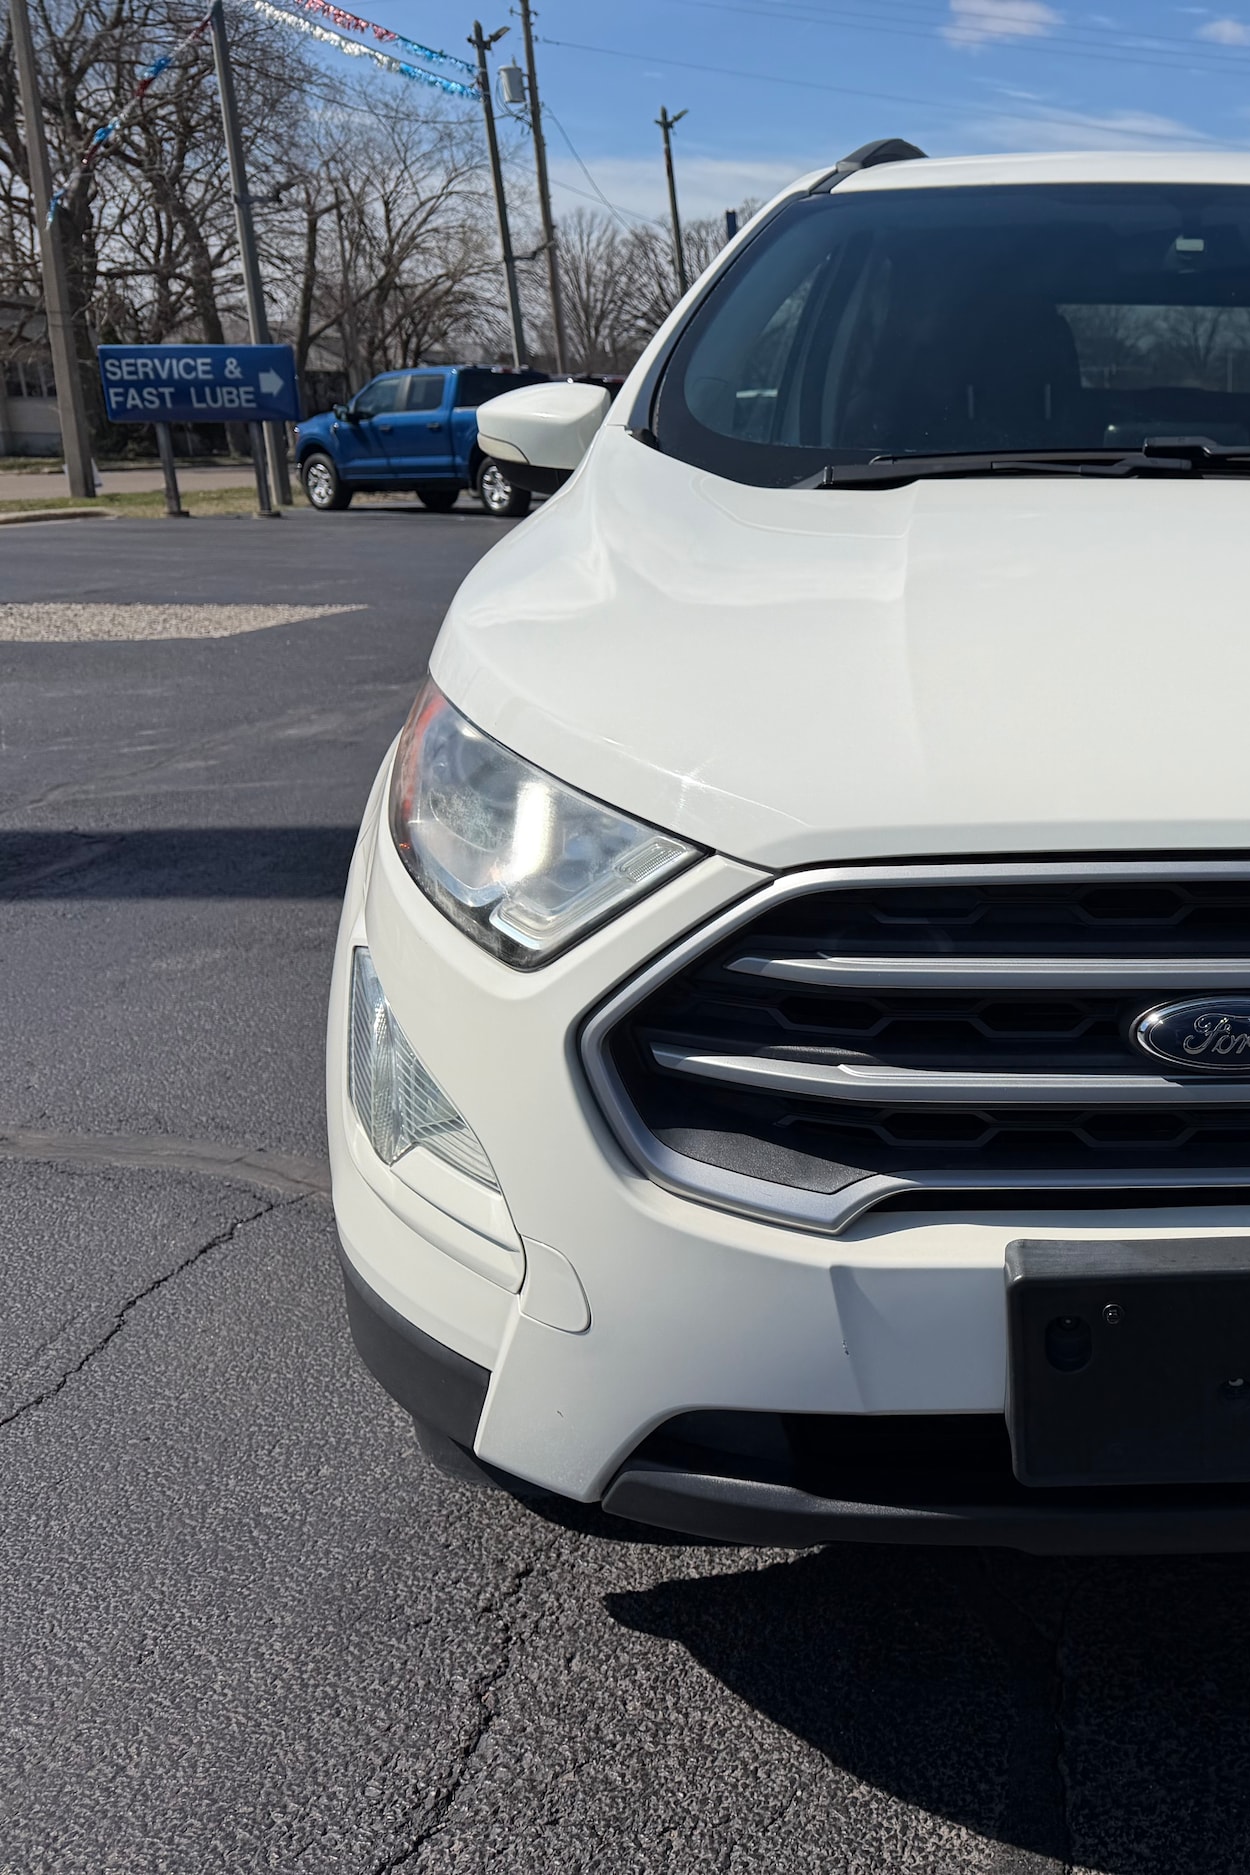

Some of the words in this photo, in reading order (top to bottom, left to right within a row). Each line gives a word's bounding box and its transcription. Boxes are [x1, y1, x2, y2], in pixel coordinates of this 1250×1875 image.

[105, 357, 214, 380] SERVICE
[224, 356, 243, 379] &
[108, 387, 174, 409] FAST
[190, 386, 257, 408] LUBE
